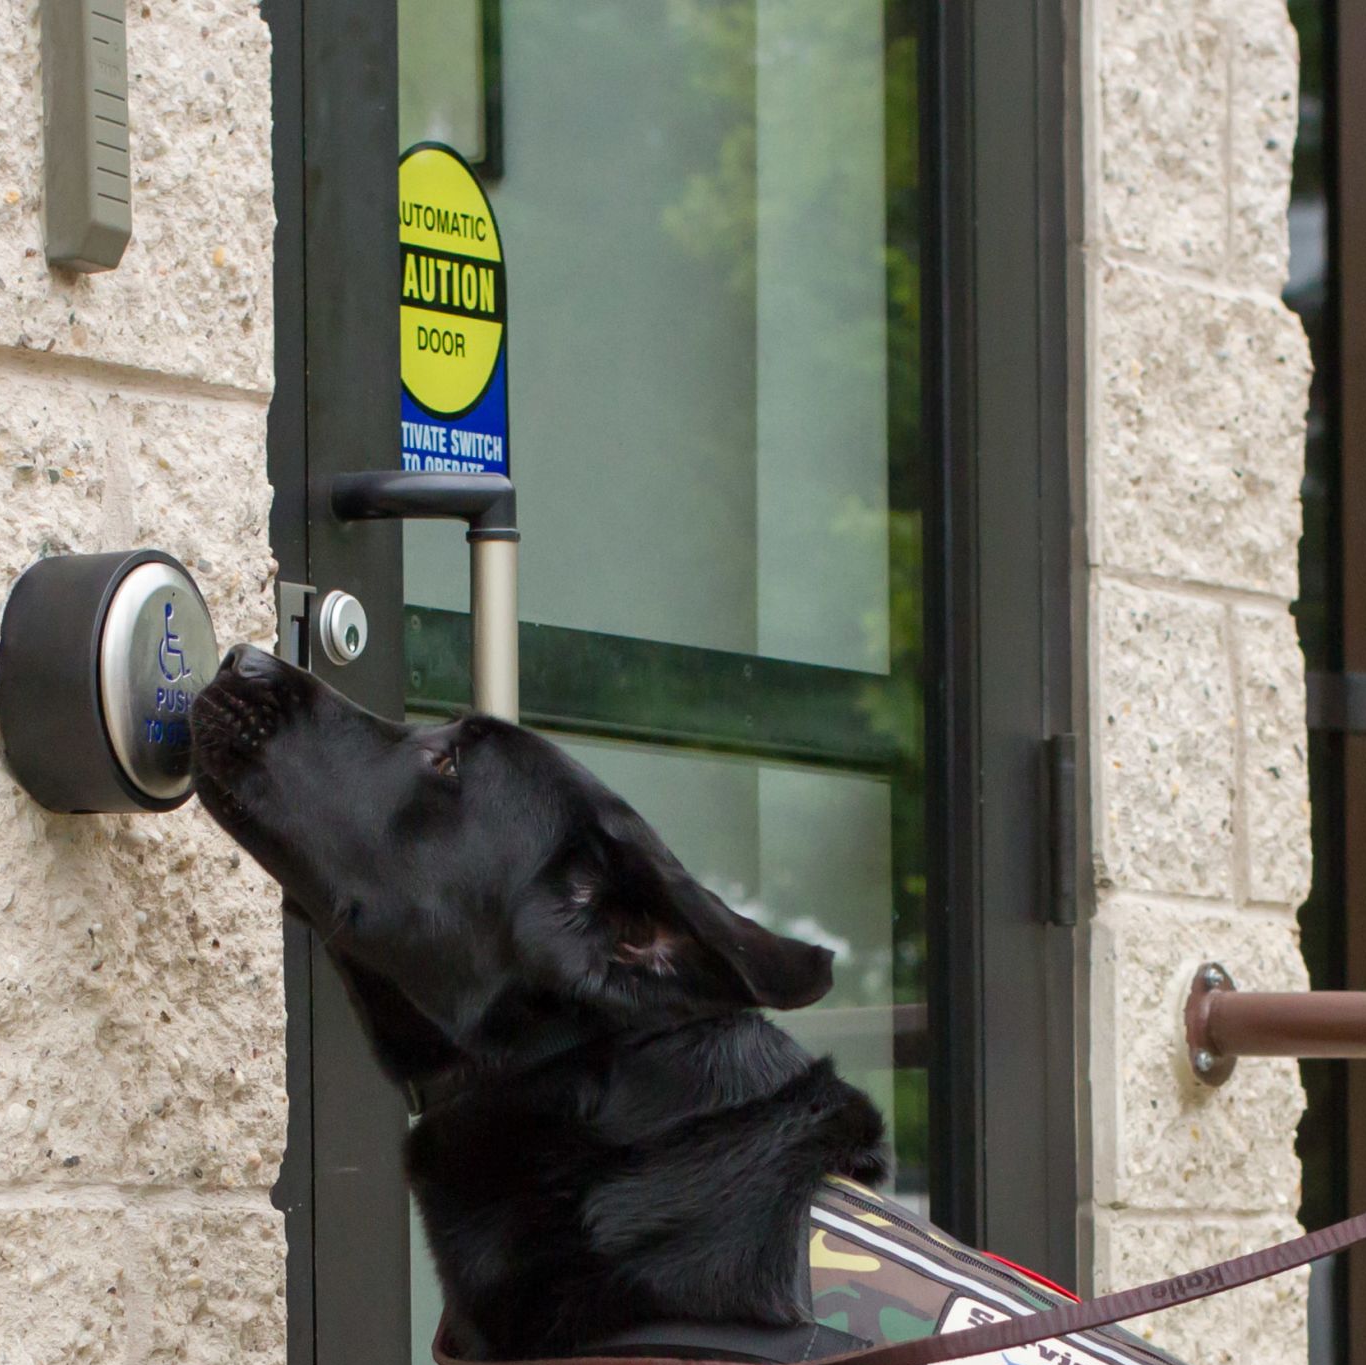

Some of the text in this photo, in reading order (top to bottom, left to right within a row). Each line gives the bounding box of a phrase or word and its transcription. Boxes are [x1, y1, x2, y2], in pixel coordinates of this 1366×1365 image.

[399, 201, 486, 242] UTOMATIC
[402, 252, 495, 313] AUTION
[417, 326, 465, 358] DOOR
[401, 421, 503, 462] TIVATE SWITCH
[402, 452, 421, 471] TO
